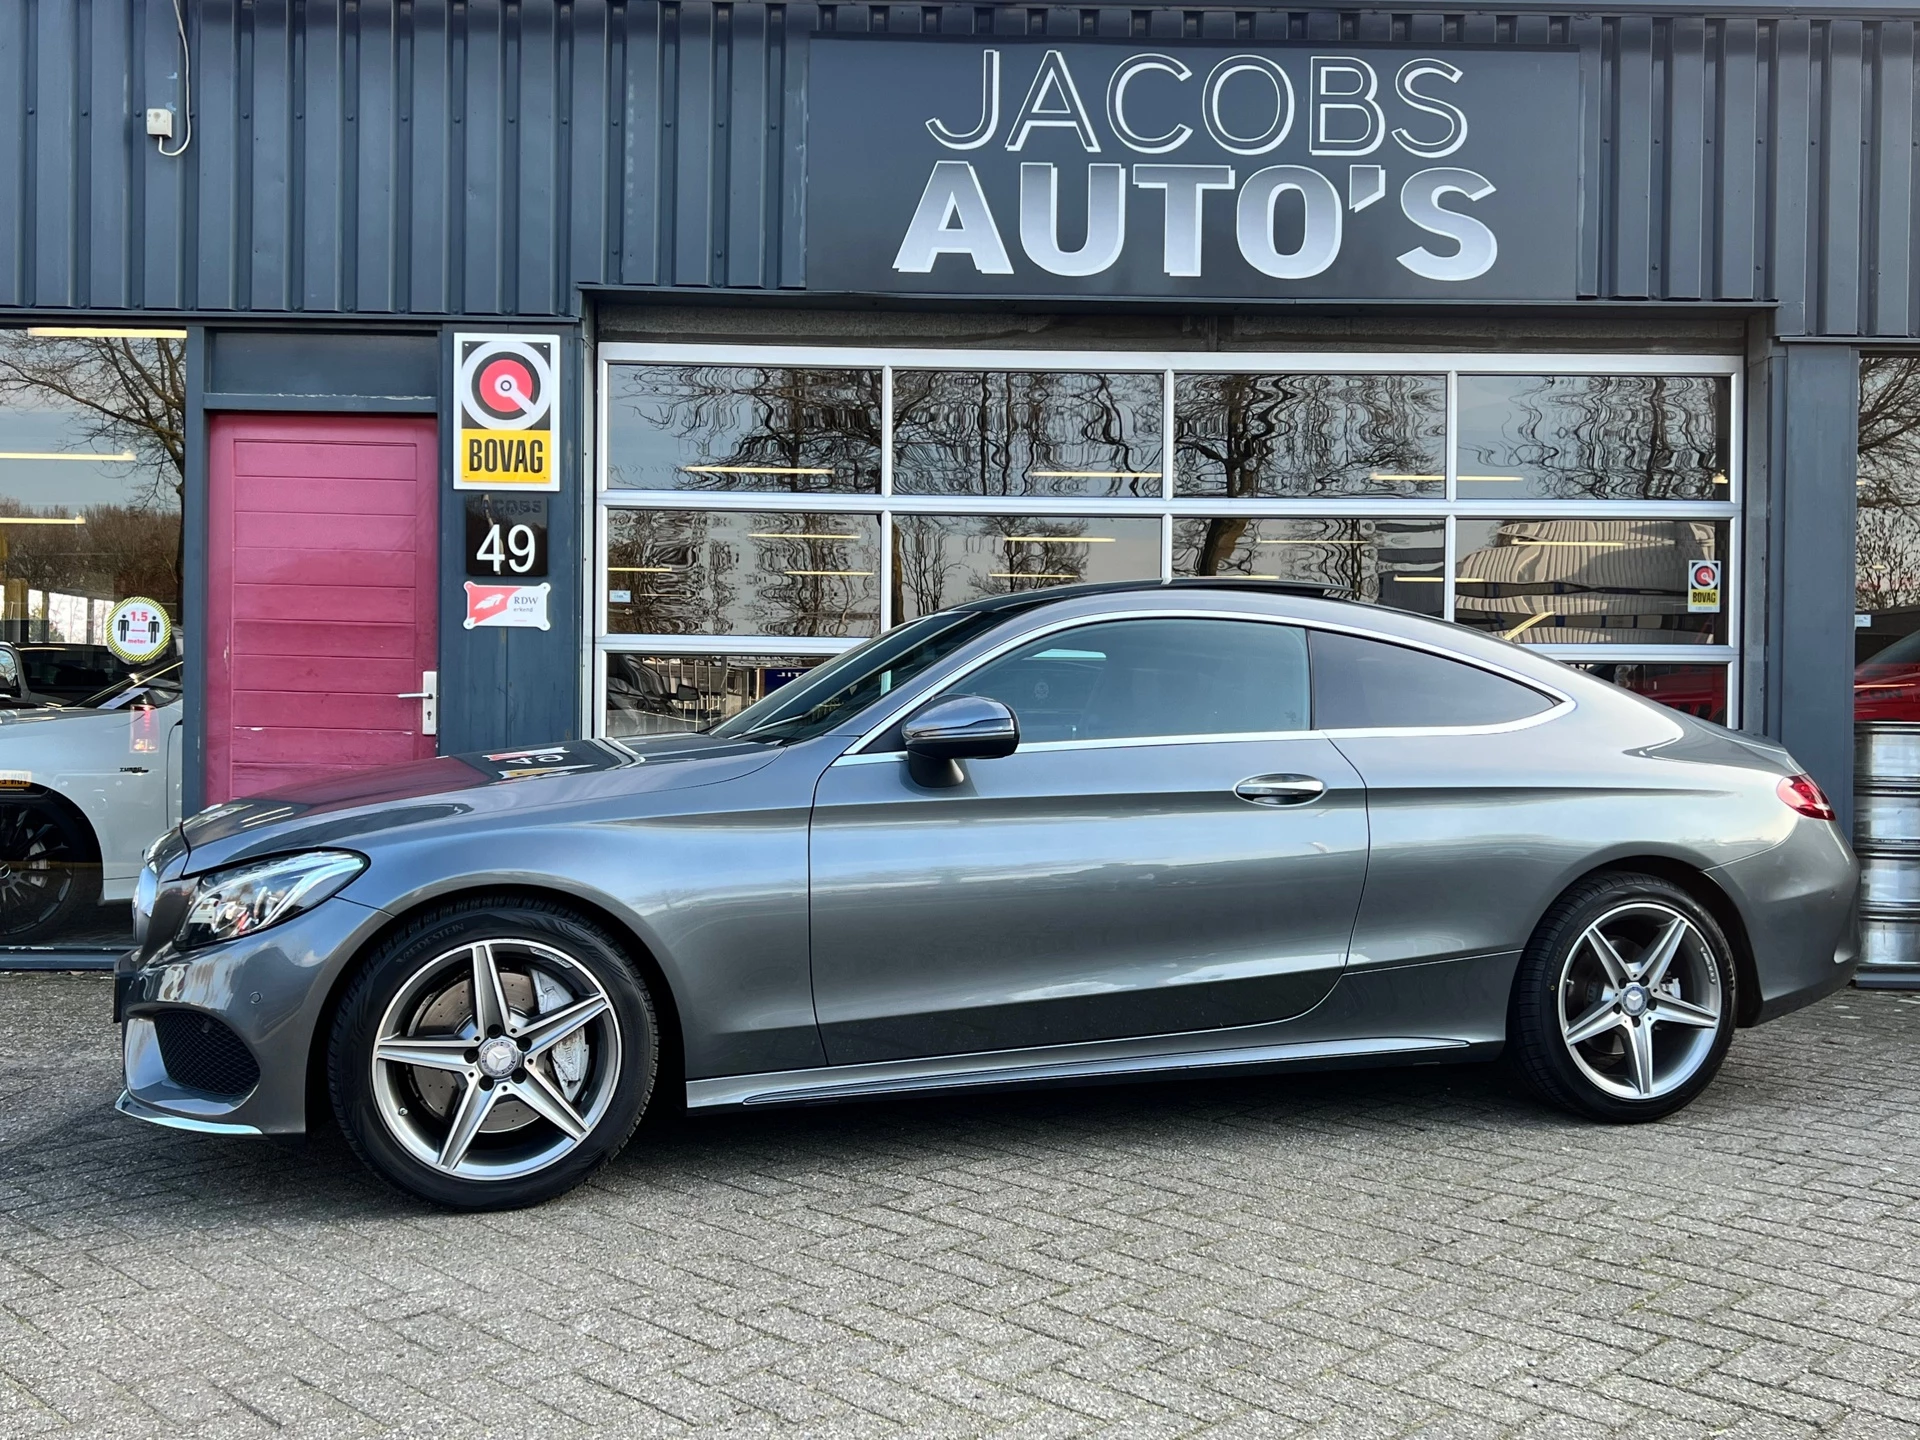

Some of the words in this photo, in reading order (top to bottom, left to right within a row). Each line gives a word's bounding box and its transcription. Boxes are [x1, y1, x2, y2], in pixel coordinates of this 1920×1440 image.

[925, 49, 1469, 158] JACOBS
[892, 160, 1498, 281] AUTO'S
[468, 438, 545, 474] BOVAG
[476, 523, 536, 574] 49
[513, 596, 539, 605] RDW
[1692, 591, 1717, 603] BOVAG
[130, 611, 149, 622] 1.5
